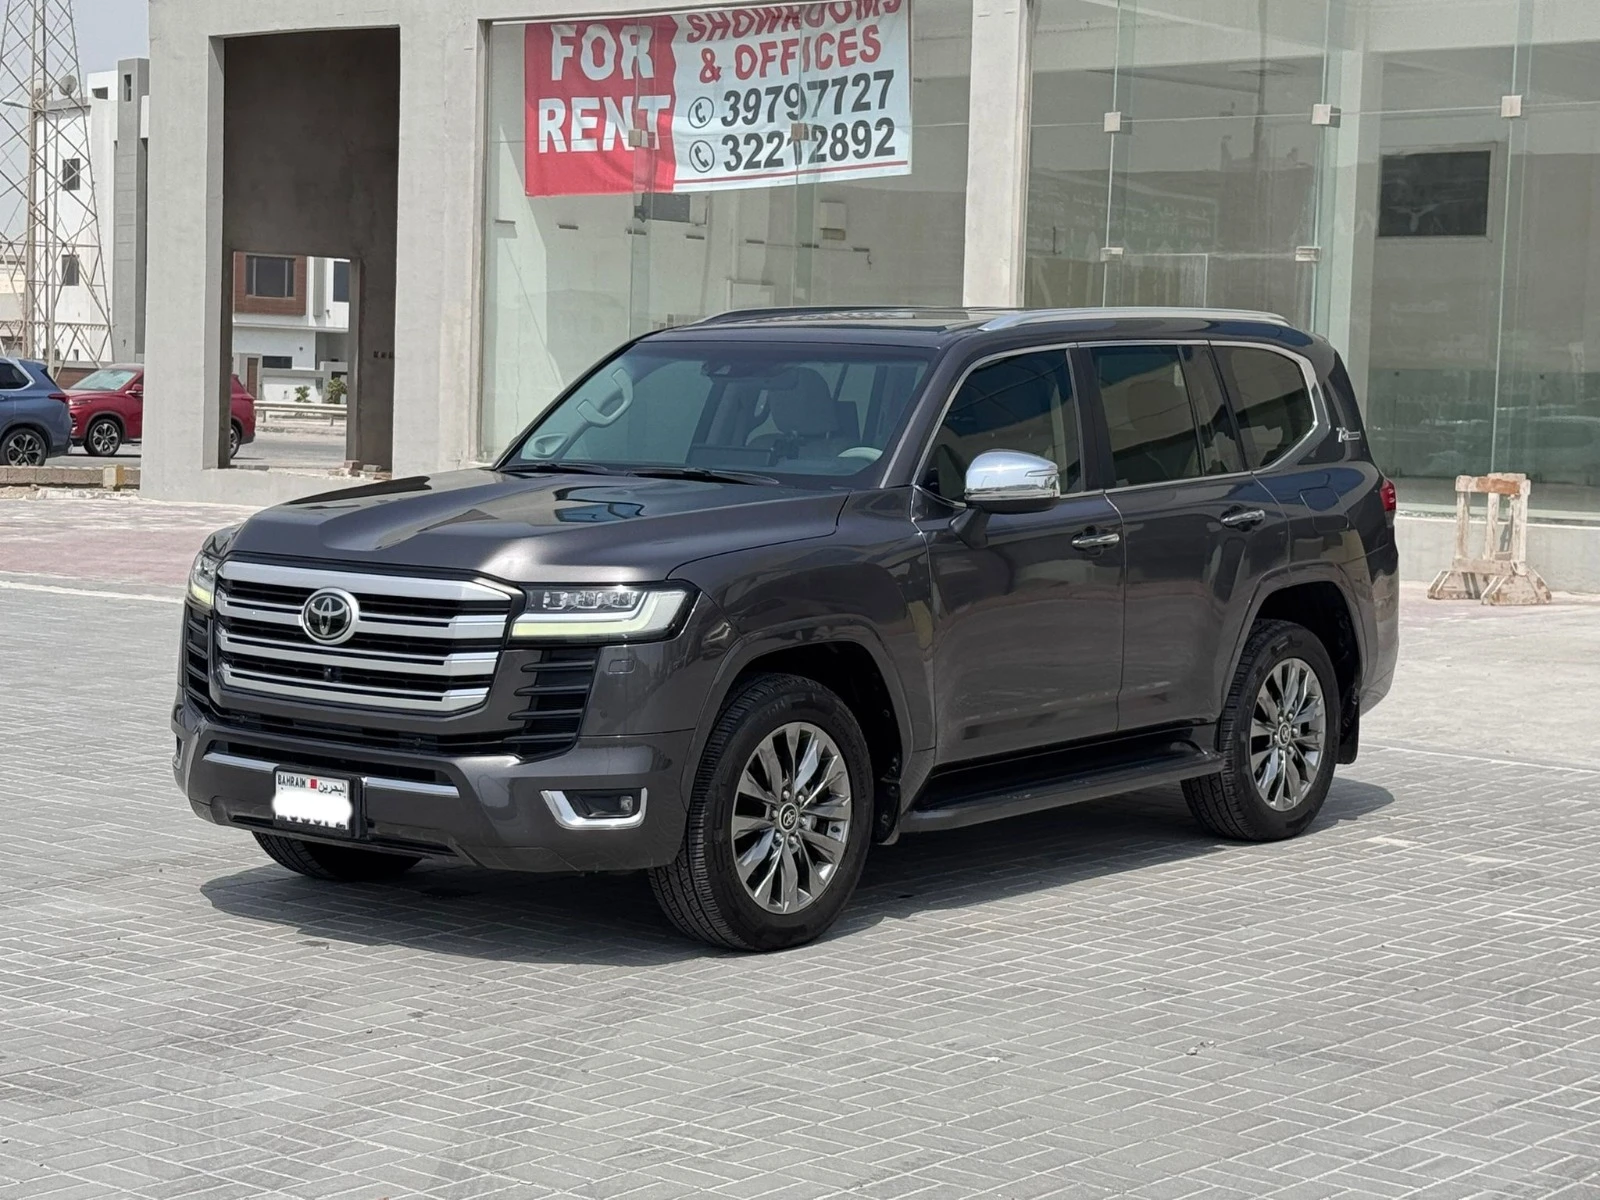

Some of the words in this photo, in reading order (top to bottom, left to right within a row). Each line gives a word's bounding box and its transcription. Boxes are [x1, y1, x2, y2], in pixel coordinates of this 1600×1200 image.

[550, 23, 655, 81] FOR
[699, 48, 722, 84] &
[735, 24, 882, 80] OFFICES
[538, 94, 672, 154] RENT
[720, 69, 895, 127] 39797727
[721, 117, 896, 172] 32212892
[277, 774, 306, 788] BAHRAIN
[318, 782, 347, 796] البحرين
